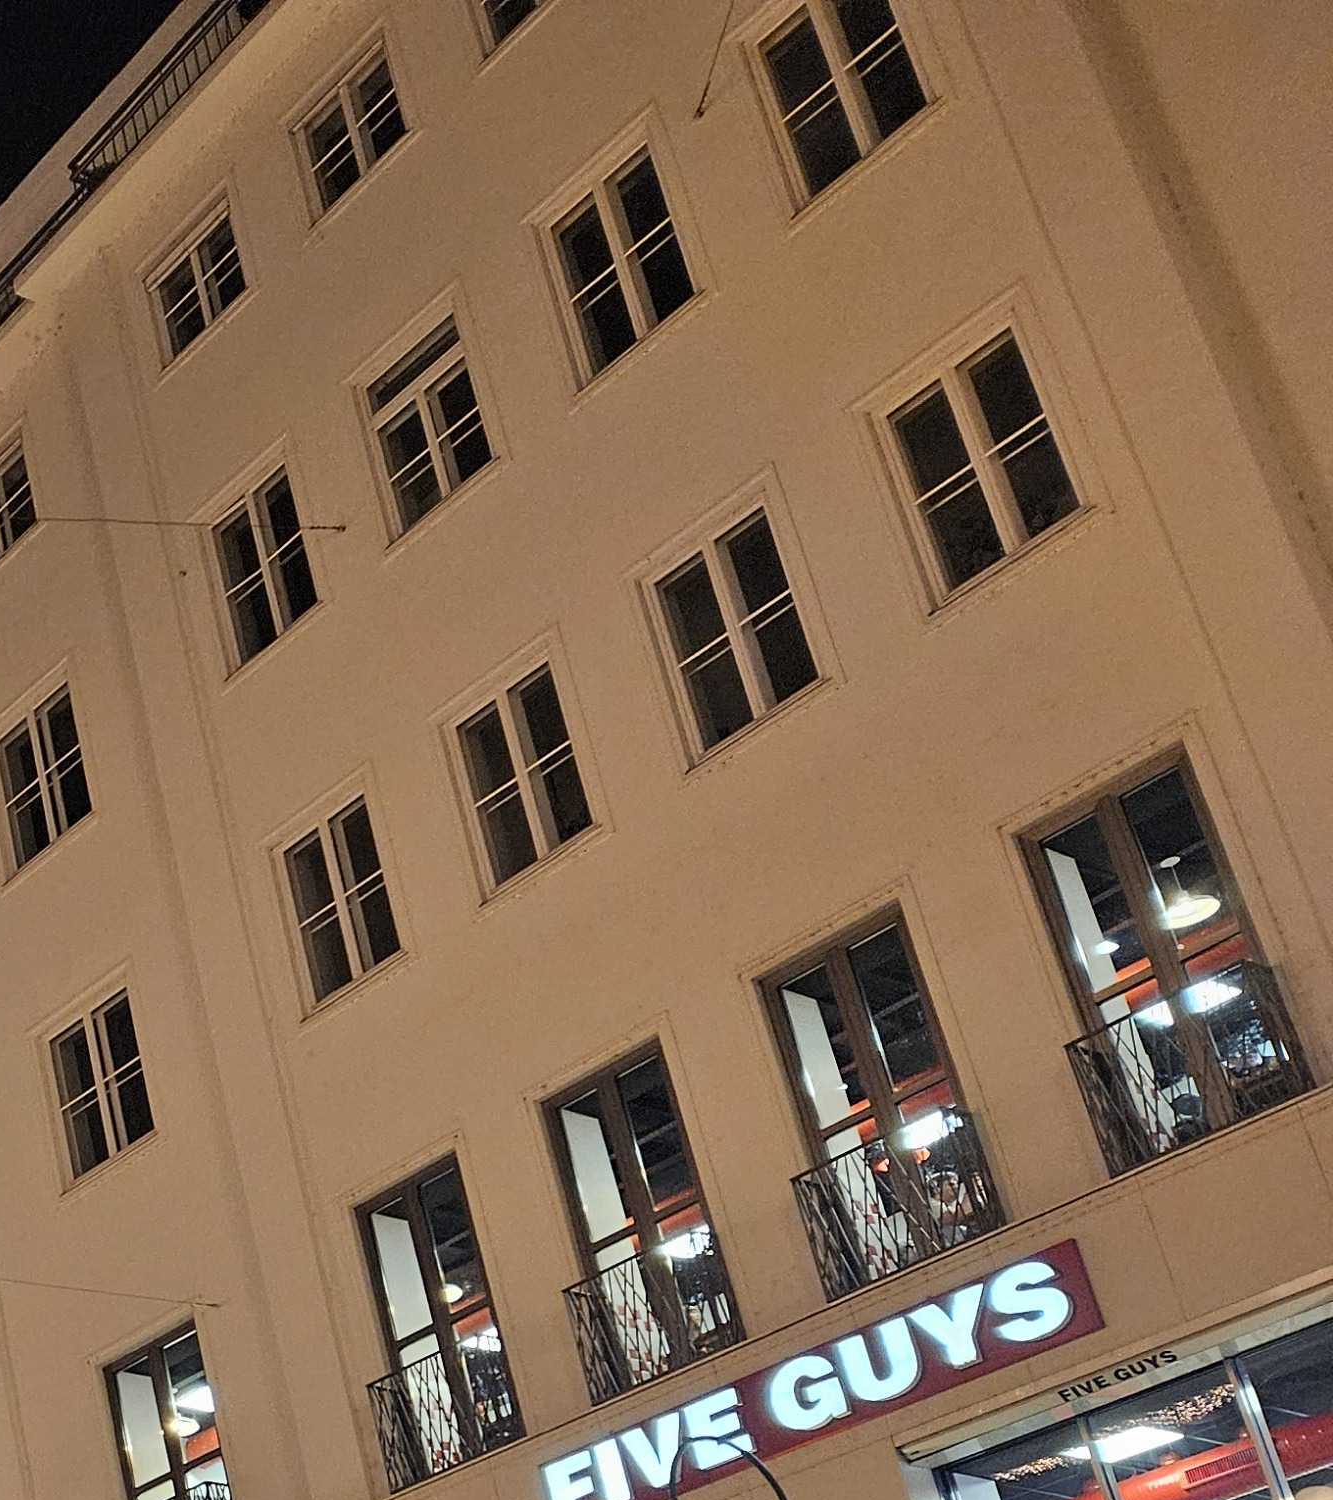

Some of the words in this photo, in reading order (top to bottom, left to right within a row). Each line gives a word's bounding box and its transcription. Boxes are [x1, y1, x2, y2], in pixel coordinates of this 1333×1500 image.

[765, 1261, 1075, 1432] GUYS
[1057, 1375, 1111, 1403] FIVE
[1113, 1350, 1178, 1381] GUYS
